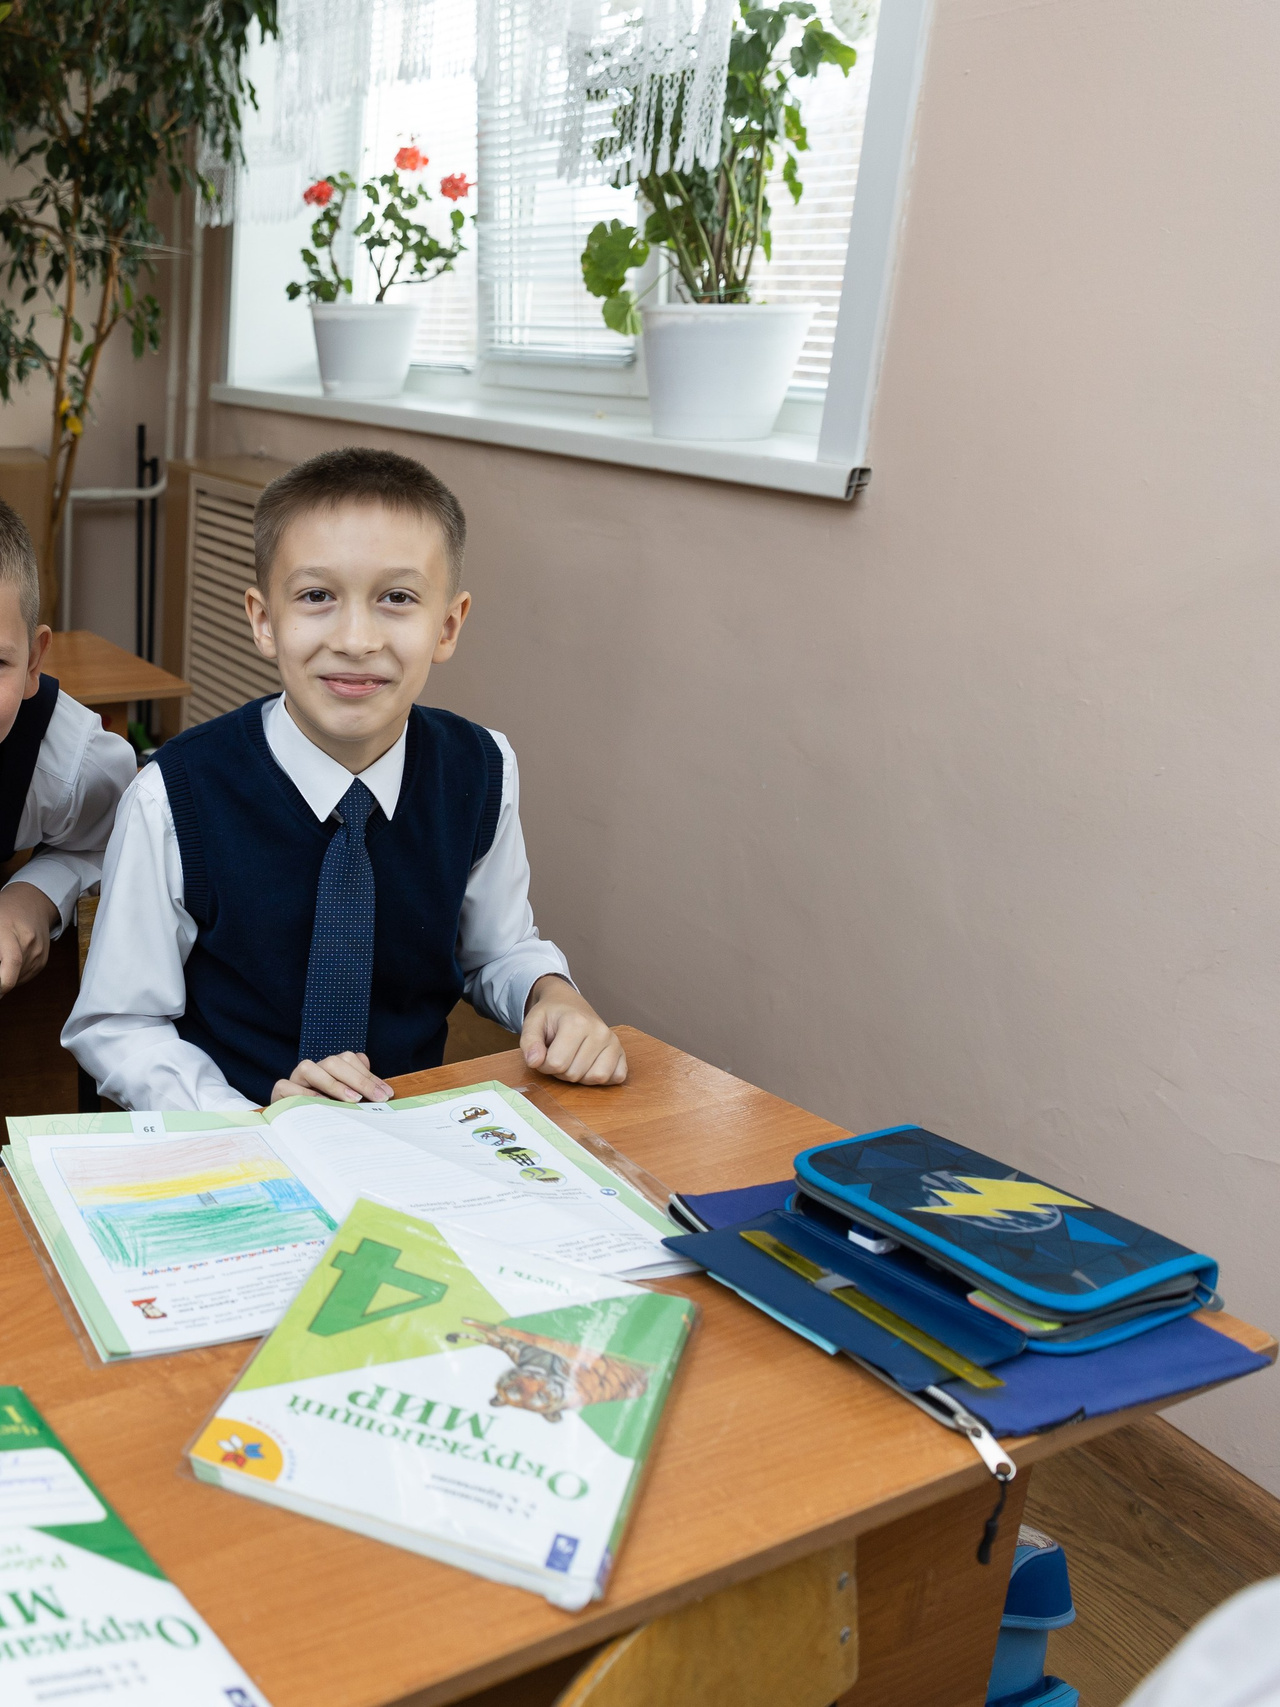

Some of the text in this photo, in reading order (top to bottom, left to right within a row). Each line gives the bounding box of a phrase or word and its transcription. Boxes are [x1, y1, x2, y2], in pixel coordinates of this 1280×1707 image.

[142, 1125, 156, 1133] 39
[308, 1237, 449, 1337] 4
[286, 1394, 589, 1500] Окружающий
[347, 1383, 498, 1440] МИР
